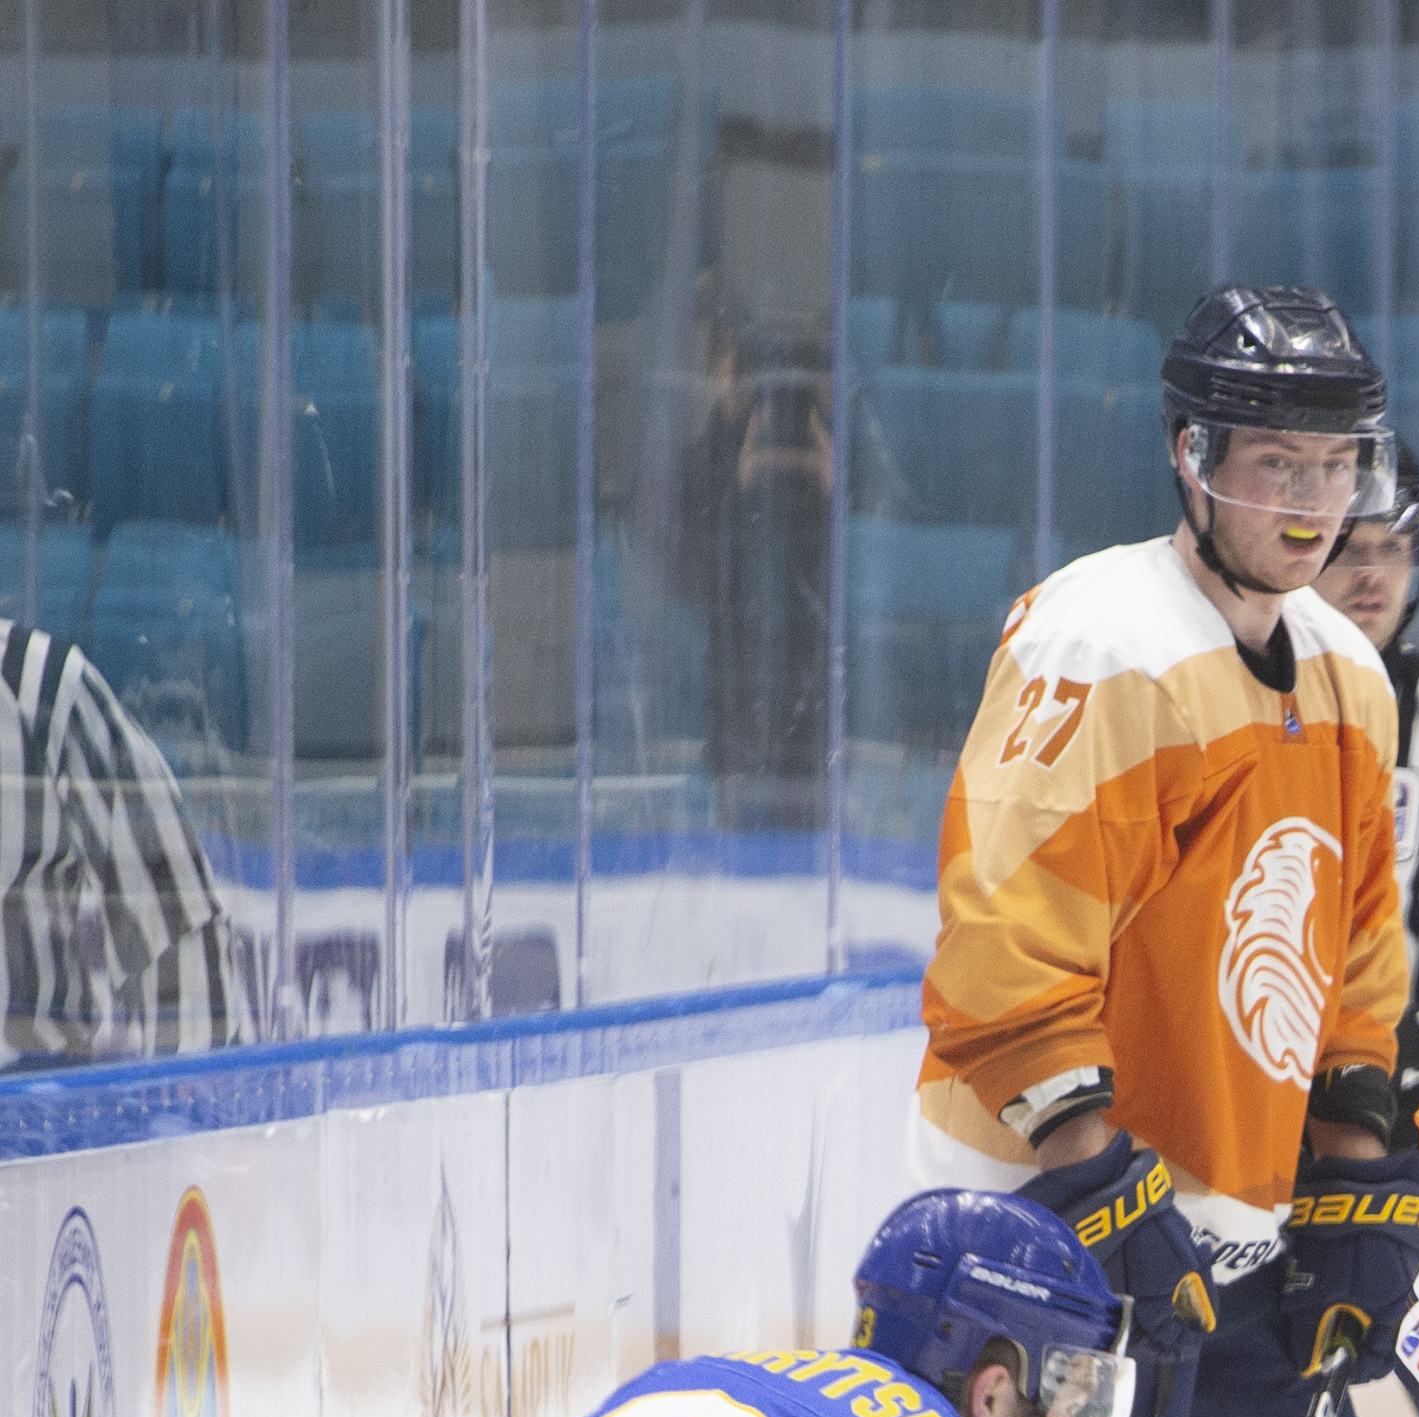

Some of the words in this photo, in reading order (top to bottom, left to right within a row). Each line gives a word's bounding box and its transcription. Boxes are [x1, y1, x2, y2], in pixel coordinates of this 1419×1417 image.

[997, 673, 1095, 771] 27
[1073, 1156, 1174, 1250] AUE
[969, 1265, 1051, 1302] BAUER
